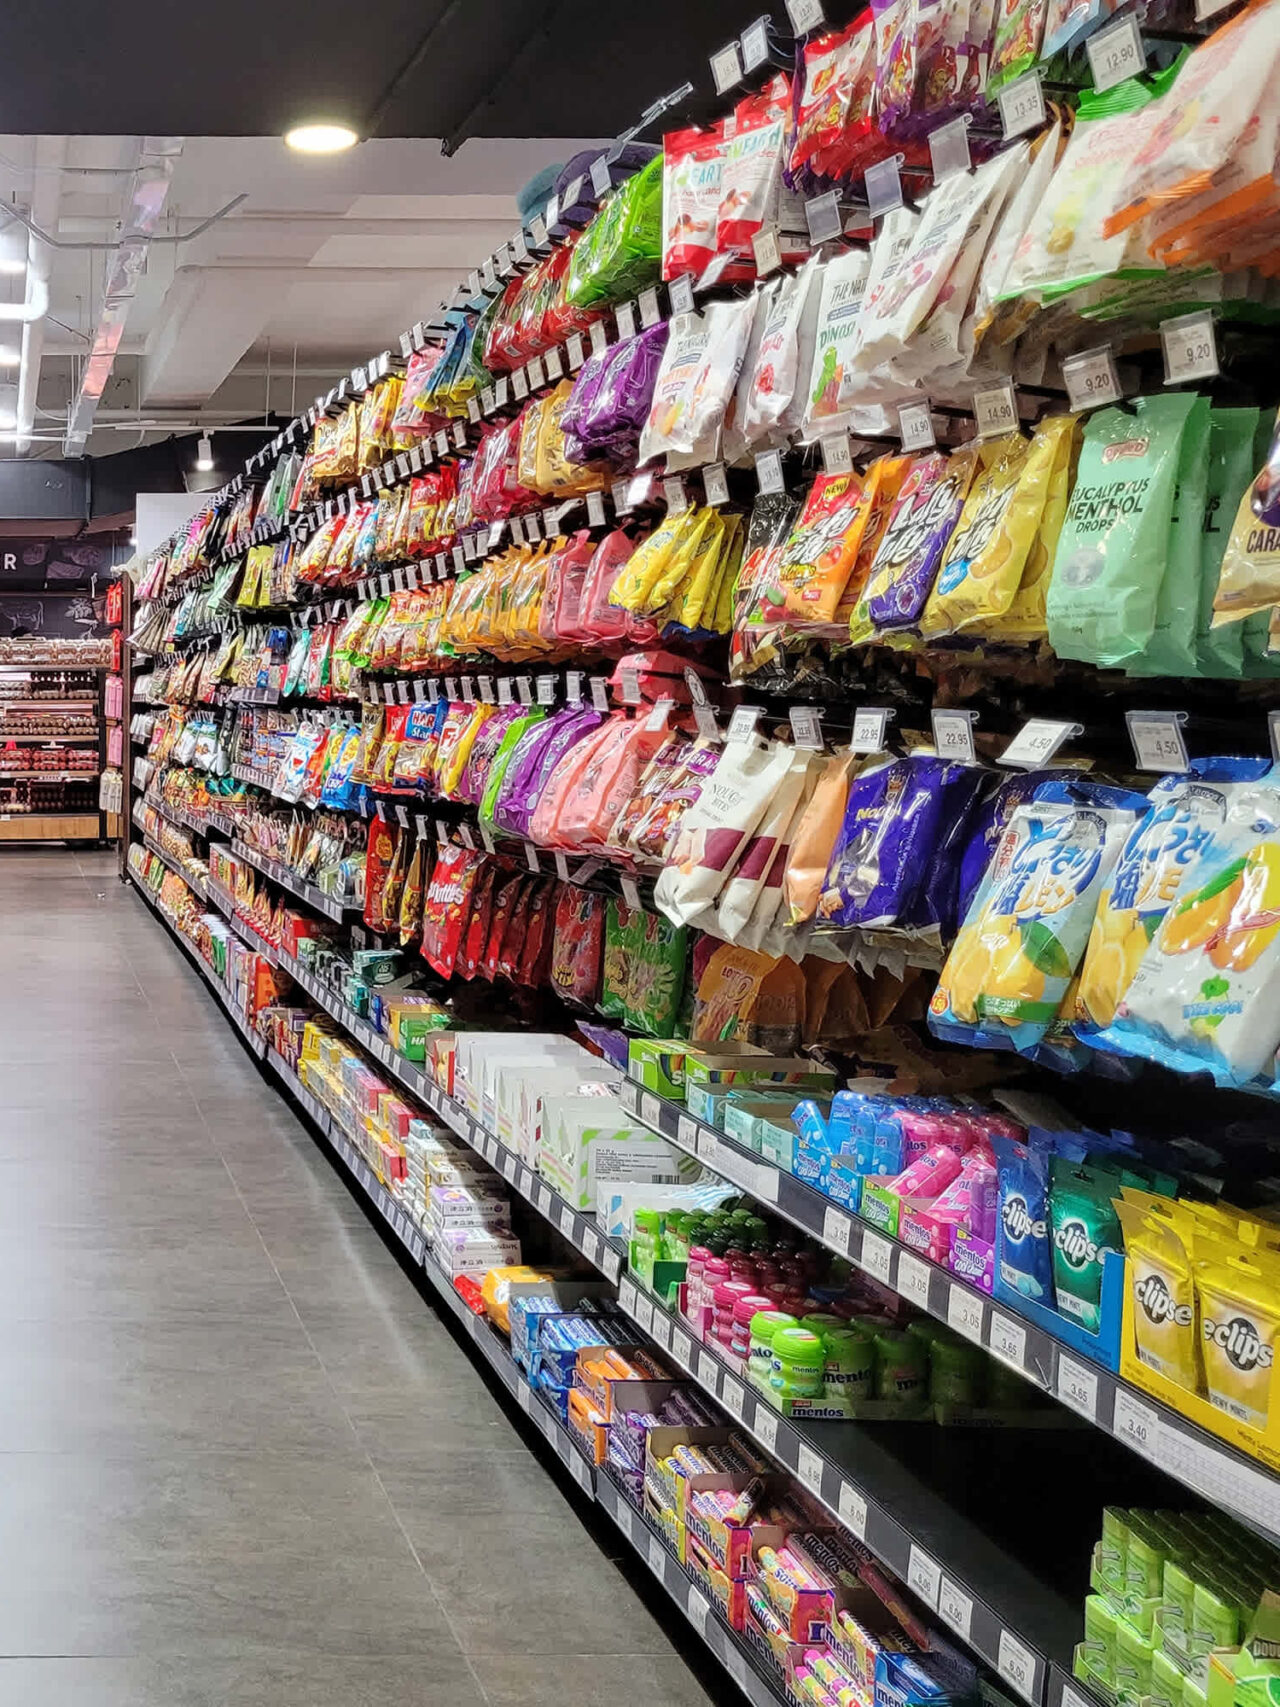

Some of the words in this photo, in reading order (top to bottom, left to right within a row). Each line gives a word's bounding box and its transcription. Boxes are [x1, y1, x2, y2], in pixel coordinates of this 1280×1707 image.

[1106, 45, 1134, 69] 12.90
[1186, 343, 1210, 362] 9.20
[1086, 373, 1109, 391] 9.20
[987, 405, 1011, 419] 14.90
[911, 419, 929, 434] 14.90
[824, 480, 849, 497] NEW!
[1075, 518, 1115, 534] DROPS
[861, 728, 879, 741] 22.95
[945, 732, 968, 745] 22.95
[1155, 740, 1179, 758] 4.50
[798, 1152, 821, 1172] mentos
[829, 1172, 851, 1193] mentos
[865, 1193, 890, 1214] mentos
[903, 1218, 931, 1241] mentos
[1001, 1204, 1048, 1238] clipse
[954, 1242, 986, 1269] mentos
[910, 1275, 927, 1294] 3.05
[1135, 1280, 1193, 1326] clipse
[962, 1309, 979, 1329] 3.05
[1002, 1337, 1017, 1356] 3.65
[1202, 1317, 1274, 1369] eclips
[1071, 1383, 1088, 1403] 3.65
[793, 1407, 844, 1418] mentos
[1228, 1402, 1249, 1421] MINTS
[1128, 1420, 1147, 1440] 3.40
[686, 1510, 726, 1567] mentos
[806, 1534, 842, 1574] mentos
